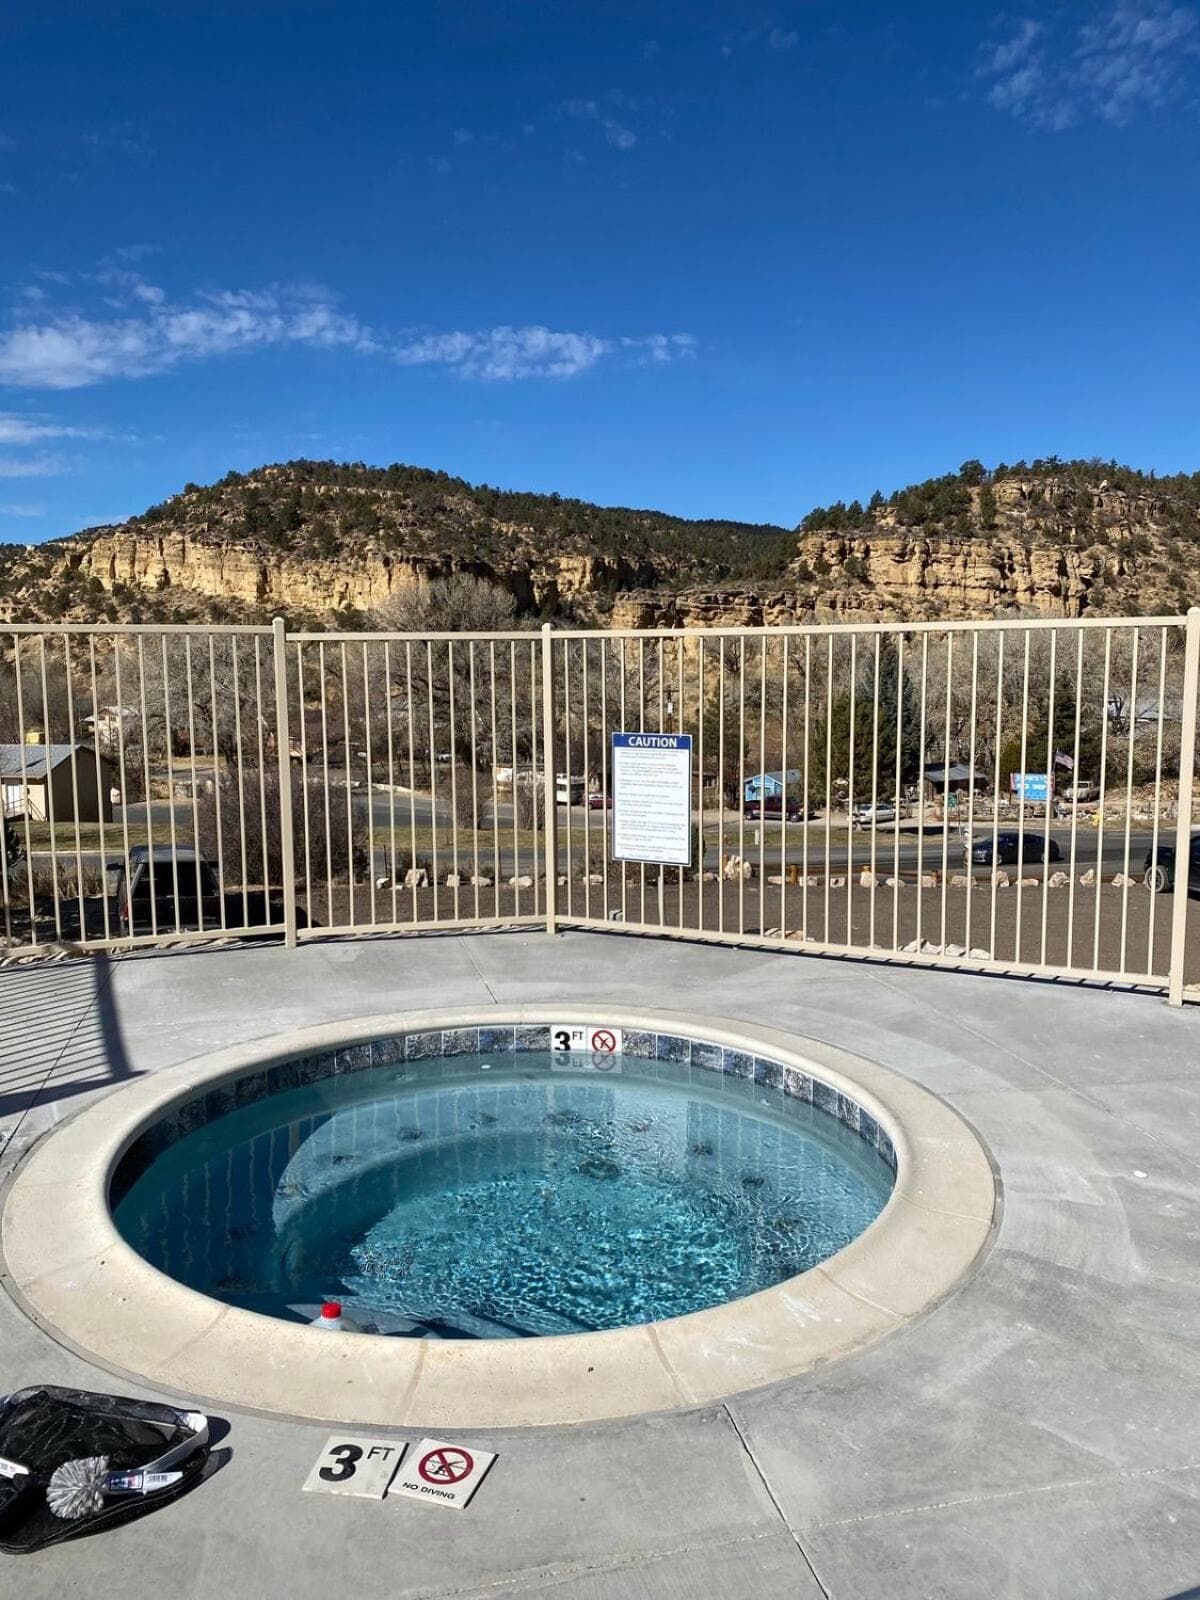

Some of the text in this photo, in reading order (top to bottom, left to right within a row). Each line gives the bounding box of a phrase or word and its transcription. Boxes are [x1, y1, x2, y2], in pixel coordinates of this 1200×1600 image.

[628, 736, 677, 747] CAUTION
[554, 1031, 583, 1051] 3 FT
[319, 1444, 395, 1482] 3 FT
[402, 1482, 455, 1499] NO DIVING
